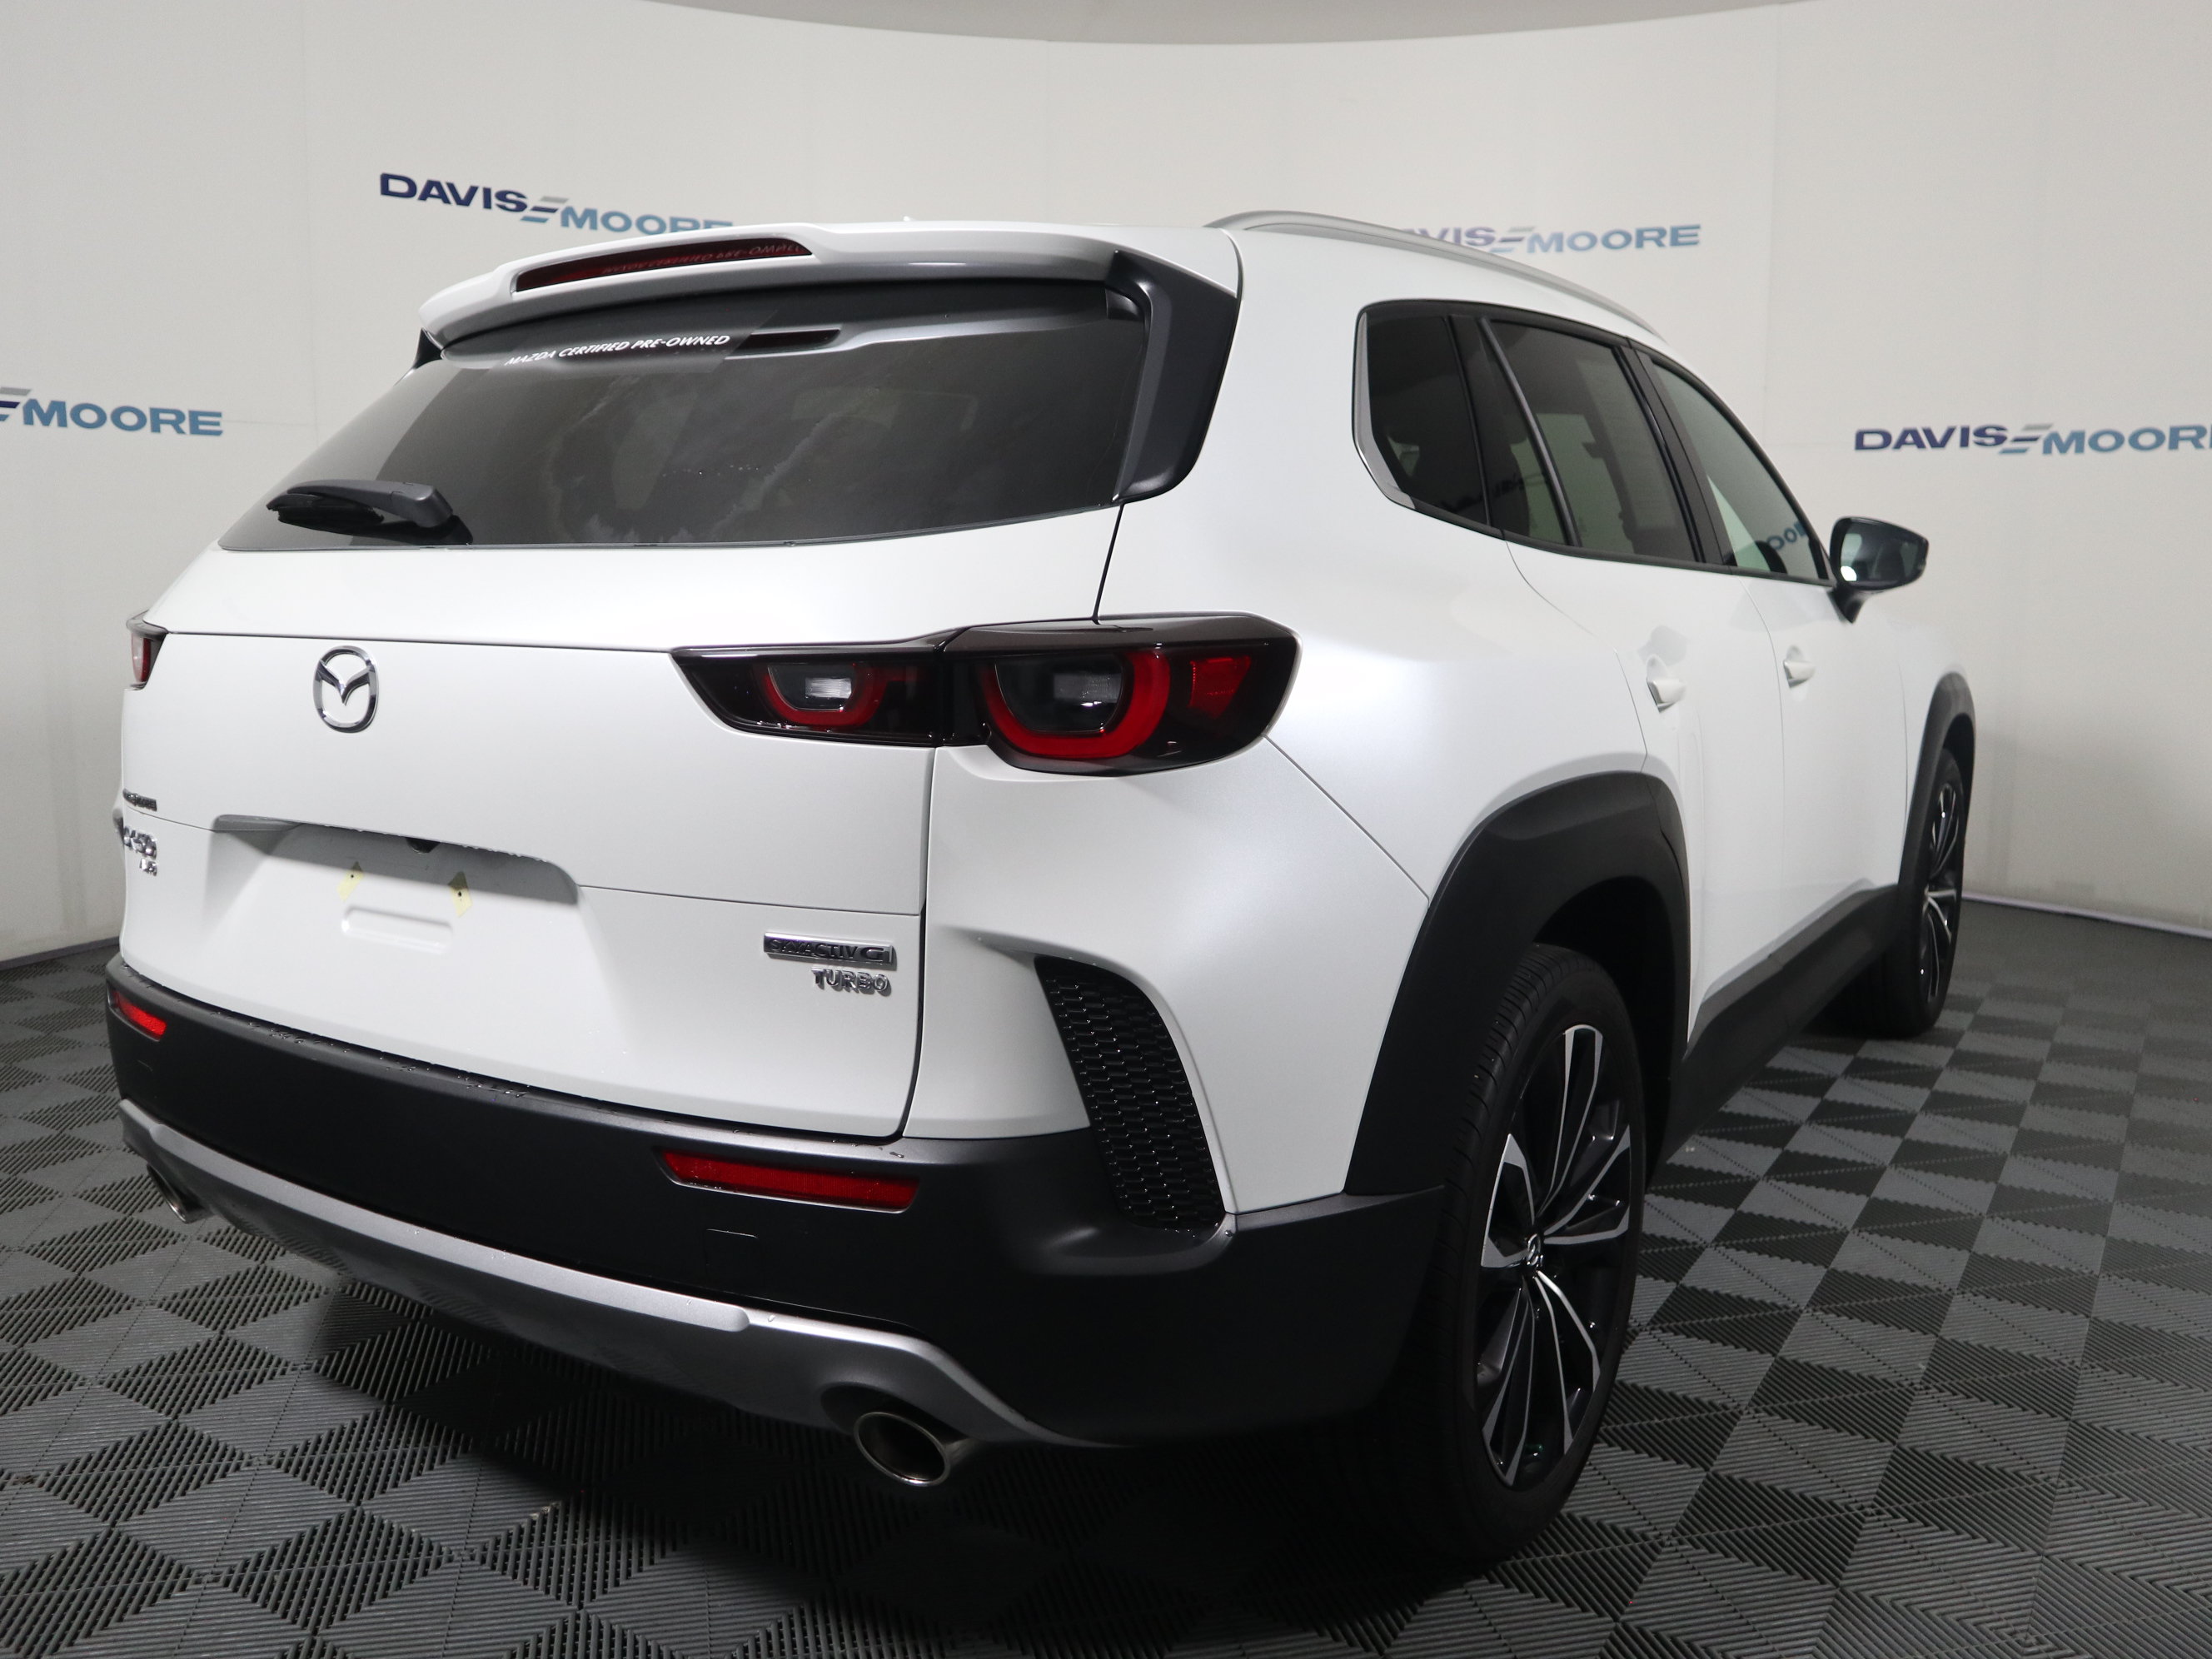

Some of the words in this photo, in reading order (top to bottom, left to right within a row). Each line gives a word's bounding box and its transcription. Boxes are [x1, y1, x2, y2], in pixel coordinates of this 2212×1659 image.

[380, 172, 528, 213] DAVIS
[560, 206, 733, 236] MOOR
[1527, 224, 1701, 253] MOORE
[504, 350, 556, 366] MAZDA
[558, 341, 630, 358] CERTIFIED
[630, 335, 731, 349] PRE-OWNED
[22, 398, 223, 436] MOORE
[1854, 425, 2008, 451] DAVIS
[2042, 424, 2212, 455] MOOR
[810, 966, 889, 992] TURBO
